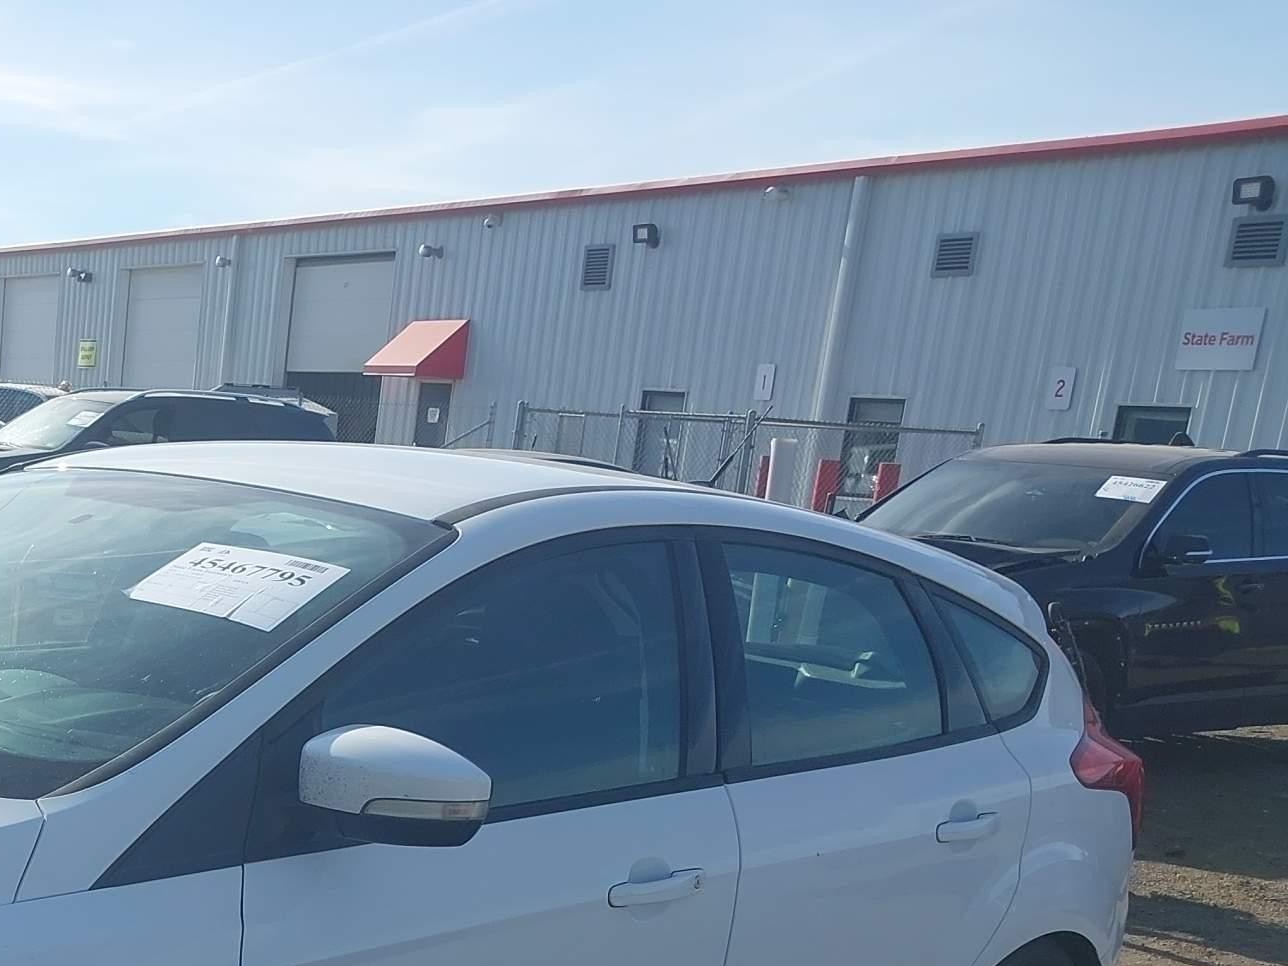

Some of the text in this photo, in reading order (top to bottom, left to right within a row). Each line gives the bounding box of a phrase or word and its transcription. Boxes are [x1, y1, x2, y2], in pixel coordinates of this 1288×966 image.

[1182, 332, 1255, 346] State Farm
[762, 374, 767, 390] 1
[1054, 379, 1066, 398] 2
[189, 557, 312, 587] 45467795
